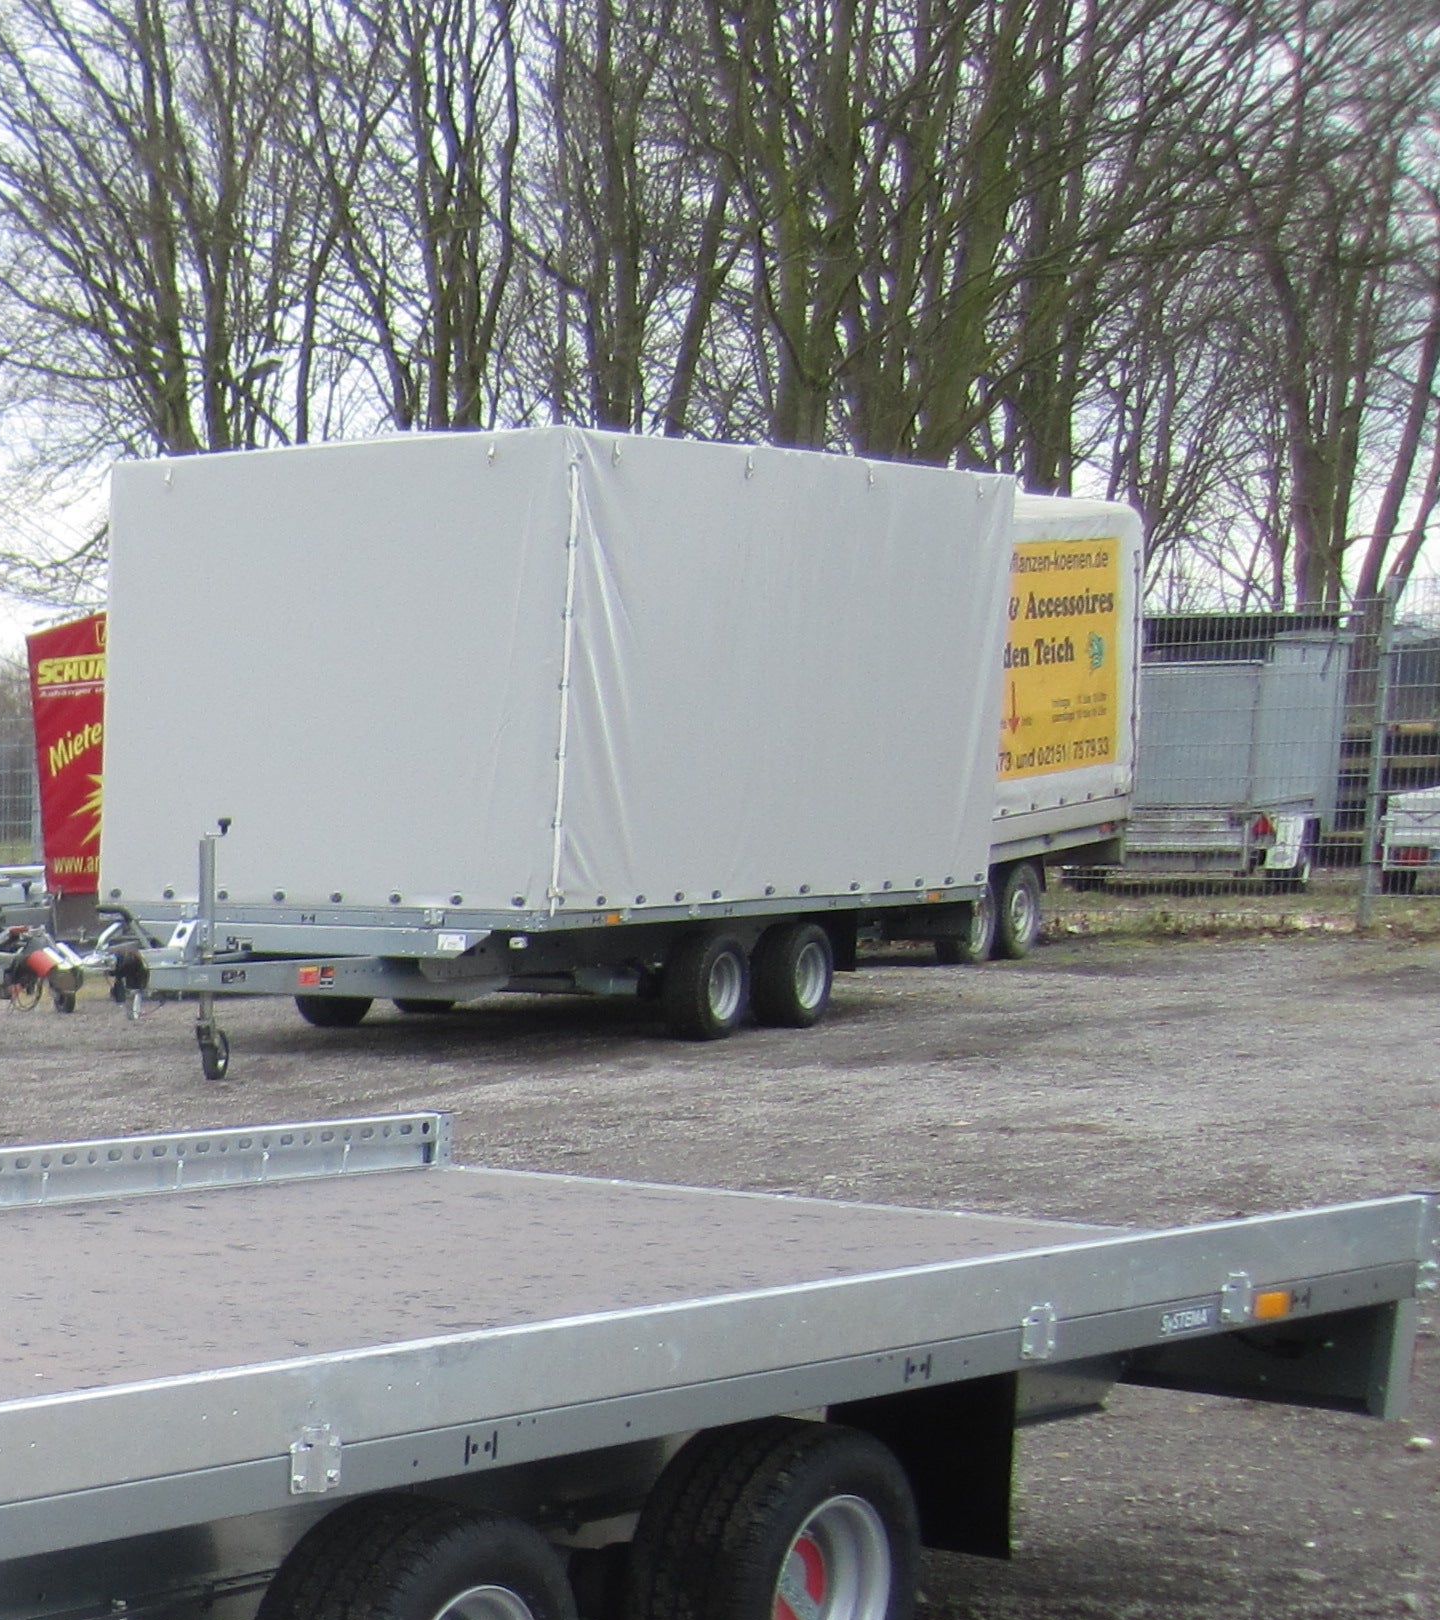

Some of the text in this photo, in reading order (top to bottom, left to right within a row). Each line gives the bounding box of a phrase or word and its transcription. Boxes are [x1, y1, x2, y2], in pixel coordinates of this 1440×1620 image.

[1008, 550, 1109, 573] flanzen-koenen.de
[1025, 587, 1114, 620] Accessoires
[1034, 636, 1075, 666] Teich
[49, 721, 103, 777] Miete
[996, 751, 1012, 772] 73
[1016, 747, 1035, 769] und
